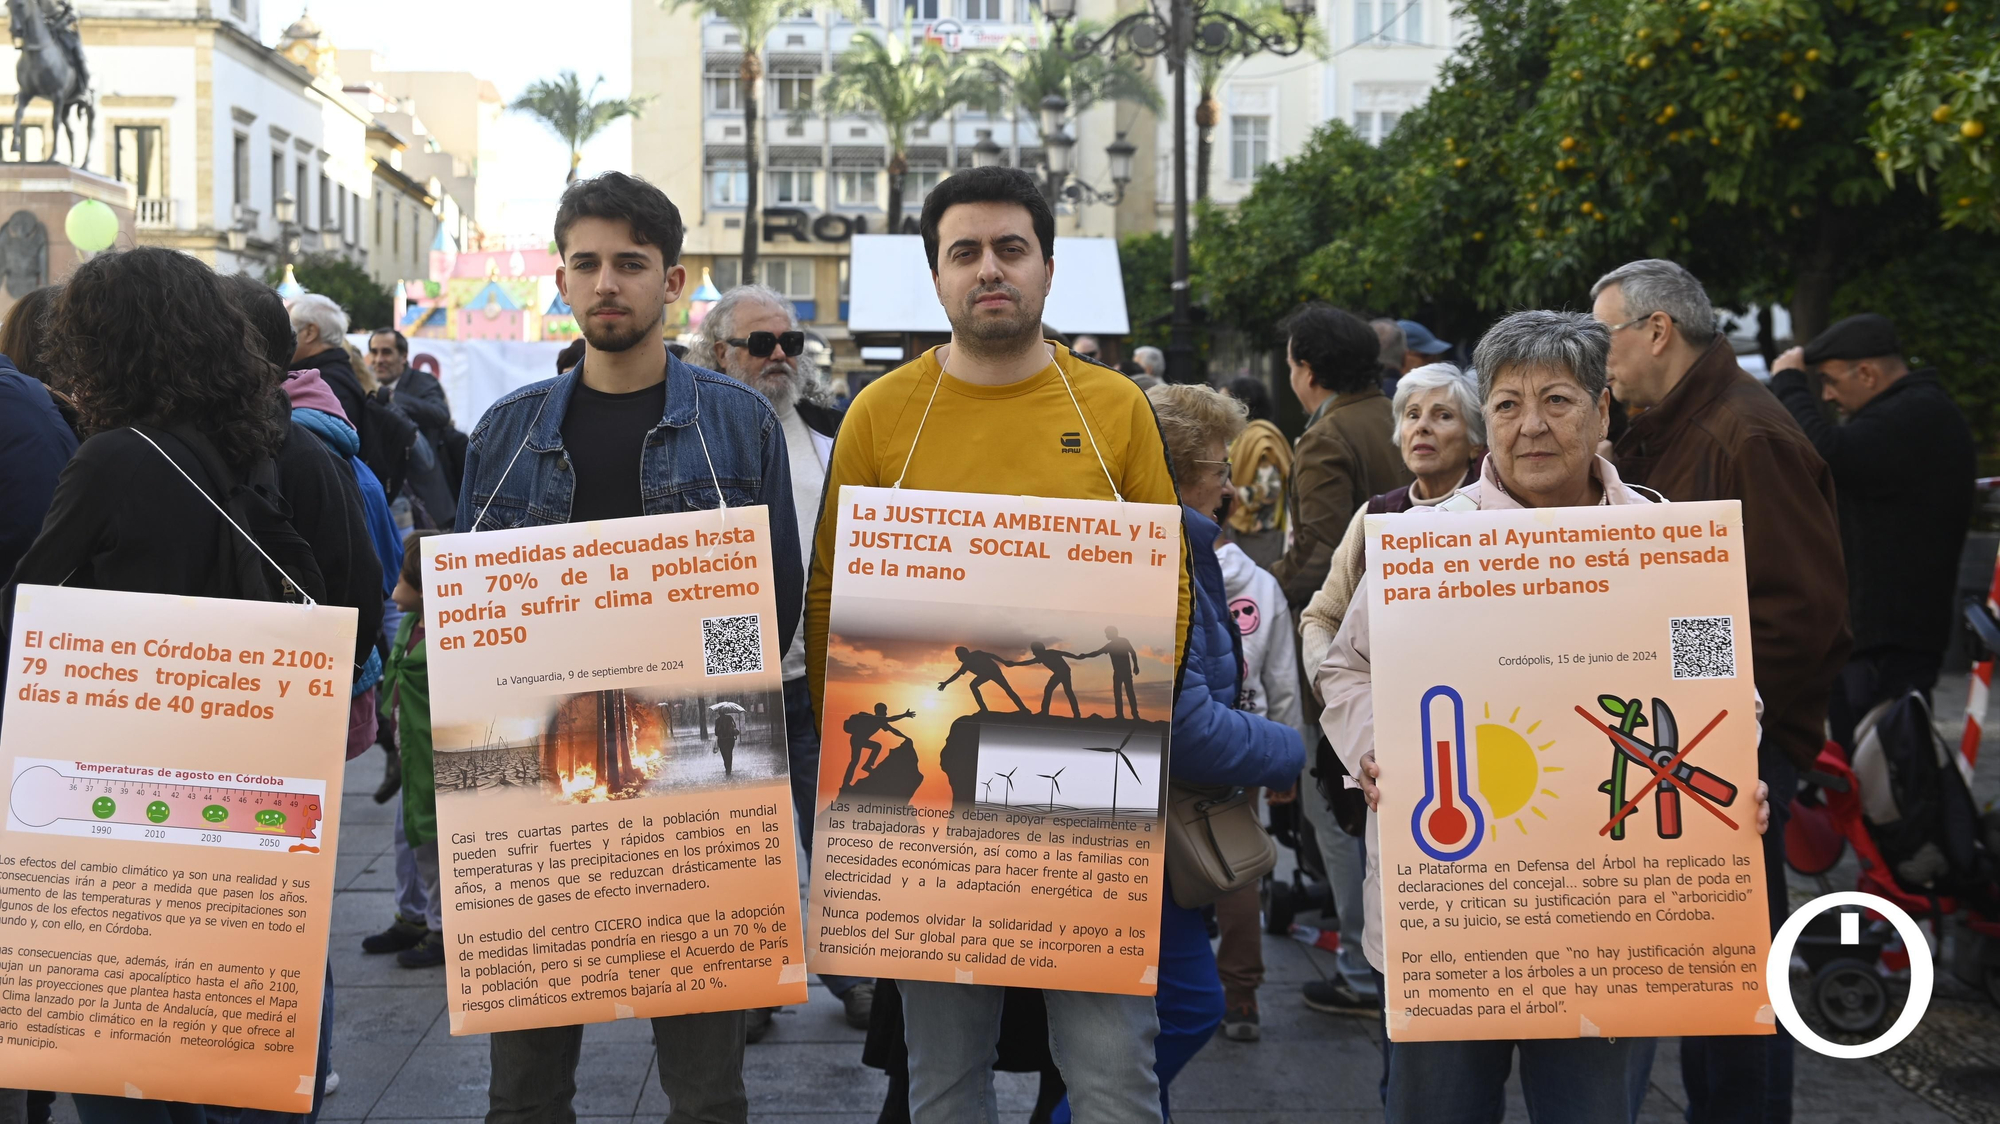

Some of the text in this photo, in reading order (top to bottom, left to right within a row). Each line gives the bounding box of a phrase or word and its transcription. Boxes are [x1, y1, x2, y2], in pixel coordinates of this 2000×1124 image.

[852, 503, 1166, 541] La JUSTICIA AMBIENTAL y la
[1381, 519, 1727, 553] Replican al Ayuntamiento que la
[434, 526, 755, 571] Sin medidas adecuadas hasta
[849, 530, 1166, 566] JUSTICIA SOCIAL deben ir
[1382, 545, 1729, 580] poda en verde no está pensada
[436, 550, 757, 598] un 70% de la población
[847, 557, 965, 581] de la mano
[438, 581, 759, 628] podría sufrir clima extremo
[1383, 577, 1609, 605] para árboles urbanos
[24, 630, 333, 670] El clima en Córdoba en 2100:
[439, 625, 527, 650] en 2050
[496, 660, 684, 686] La Vanguardia, 9 de septiembre de 2024
[1498, 650, 1657, 667] Cordópolis, 15 de junio de 2024
[22, 656, 334, 698] 79 noches tropicales y 61
[18, 682, 274, 719] días a más de 40 grados
[74, 761, 283, 786] Temperaturas de agosto en Córdoba
[103, 786, 113, 794] 38
[222, 795, 231, 803] 45
[273, 799, 282, 807] 48
[91, 825, 280, 847] 1990 2010 2030 2050
[825, 853, 1148, 884] necesidades económicas para hacer frente al gasto en
[1397, 854, 1750, 875] La Plataforma en Defensa del Árbol ha replicado las
[455, 878, 709, 911] emisiones de gases de efecto invernadero.
[457, 902, 785, 944] Un estudio del centro CICERO indica que la adopción
[1399, 907, 1714, 931] que, a su juicio, se está cometiendo en Córdoba.
[819, 941, 1056, 968] transición mejorando su calidad de vida.
[2, 989, 296, 1023] Clima lanzado por la Junta de Andalucía, que medirá el
